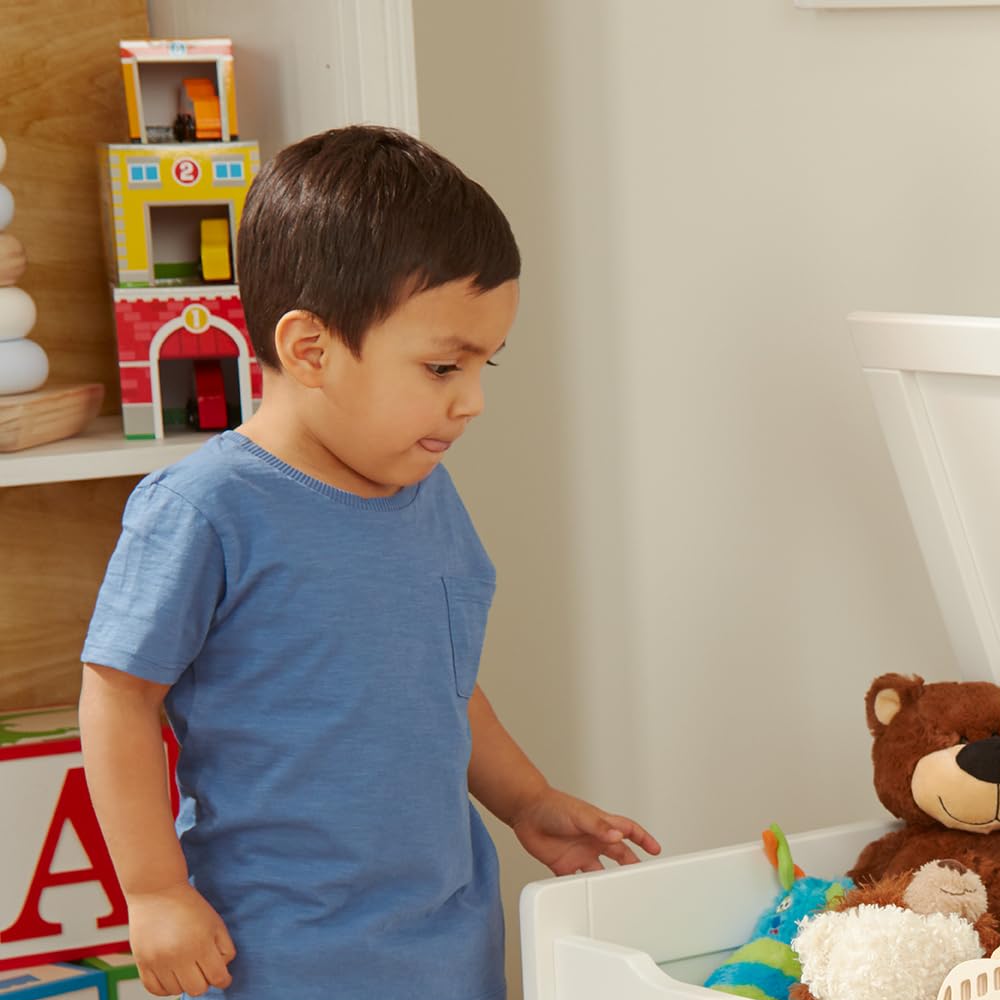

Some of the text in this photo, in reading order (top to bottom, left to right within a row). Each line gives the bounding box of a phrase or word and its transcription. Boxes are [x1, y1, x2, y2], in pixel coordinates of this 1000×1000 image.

[178, 161, 195, 182] 2
[189, 309, 201, 329] 1
[0, 767, 130, 944] A
